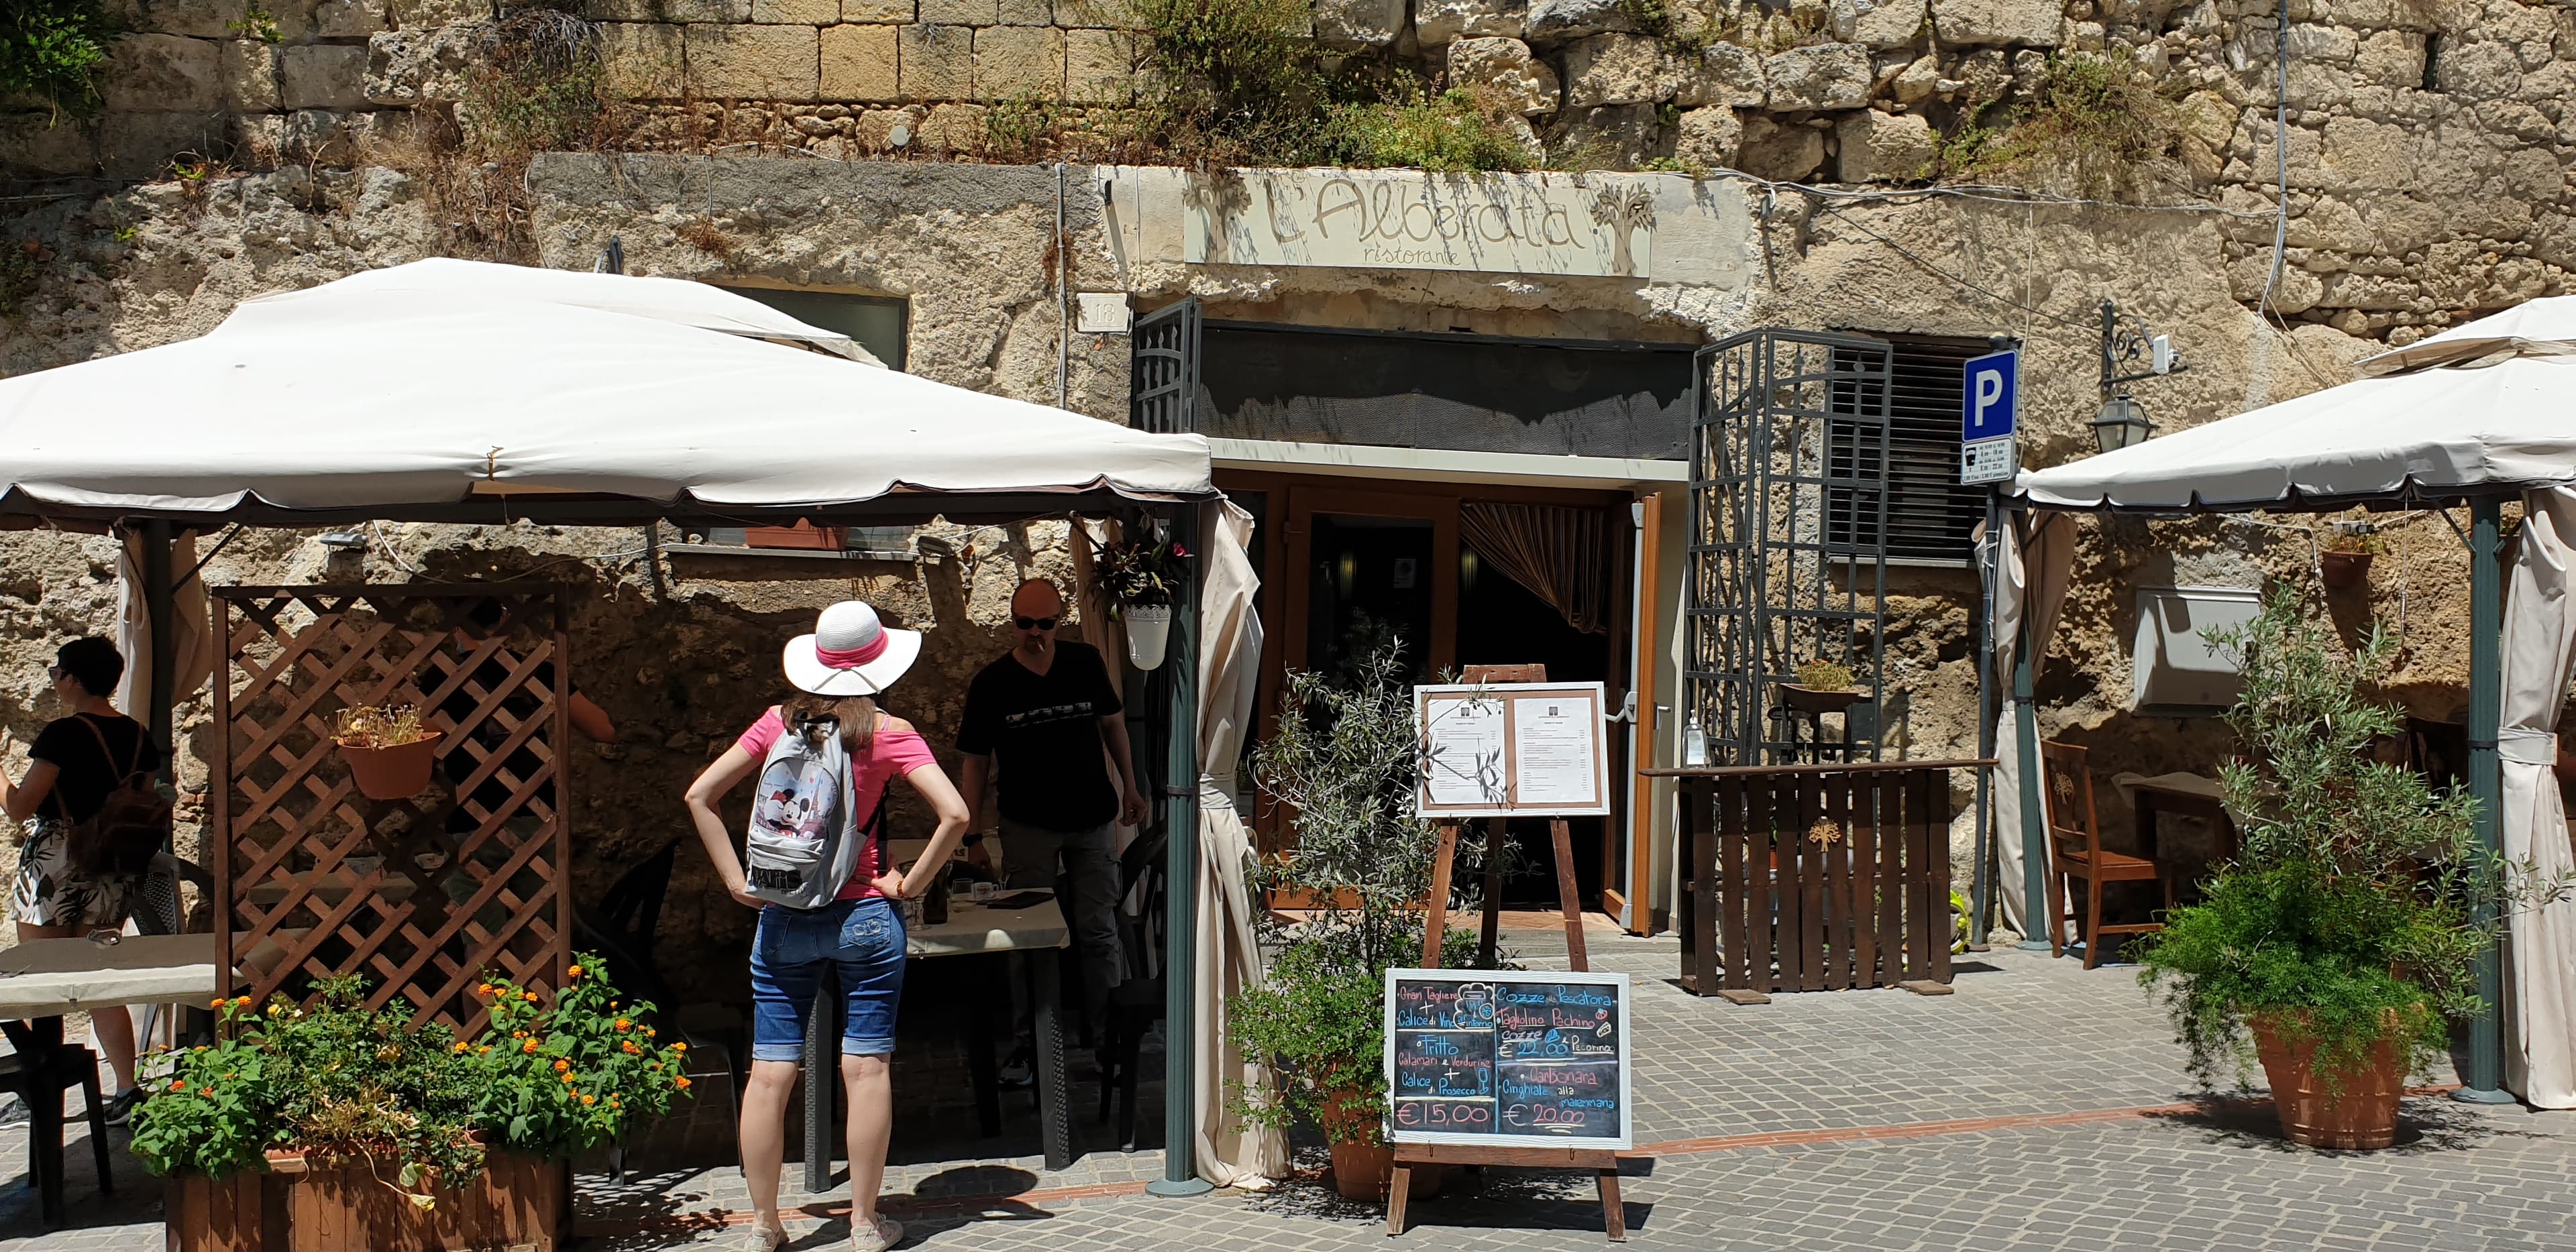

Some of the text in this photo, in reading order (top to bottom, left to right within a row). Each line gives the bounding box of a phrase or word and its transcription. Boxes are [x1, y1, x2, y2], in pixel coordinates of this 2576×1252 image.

[1263, 178, 1587, 249] L'Alberata
[1363, 243, 1461, 266] ristorante
[1095, 303, 1114, 322] 18
[1974, 369, 2002, 426] P
[1400, 986, 1459, 1003] Gran Tagliere
[1497, 987, 1544, 1003] Cozze
[1399, 1009, 1428, 1026] Calice
[1429, 1015, 1436, 1025] di
[1552, 1008, 1595, 1028] Pachino
[1399, 1052, 1438, 1066] Calamari
[1451, 1056, 1491, 1068] Verdurine
[1402, 1072, 1431, 1086] Calice
[1530, 1066, 1598, 1085] Carbonara
[1428, 1078, 1476, 1095] di Prosecco
[1503, 1079, 1574, 1099] Cinghiale alla
